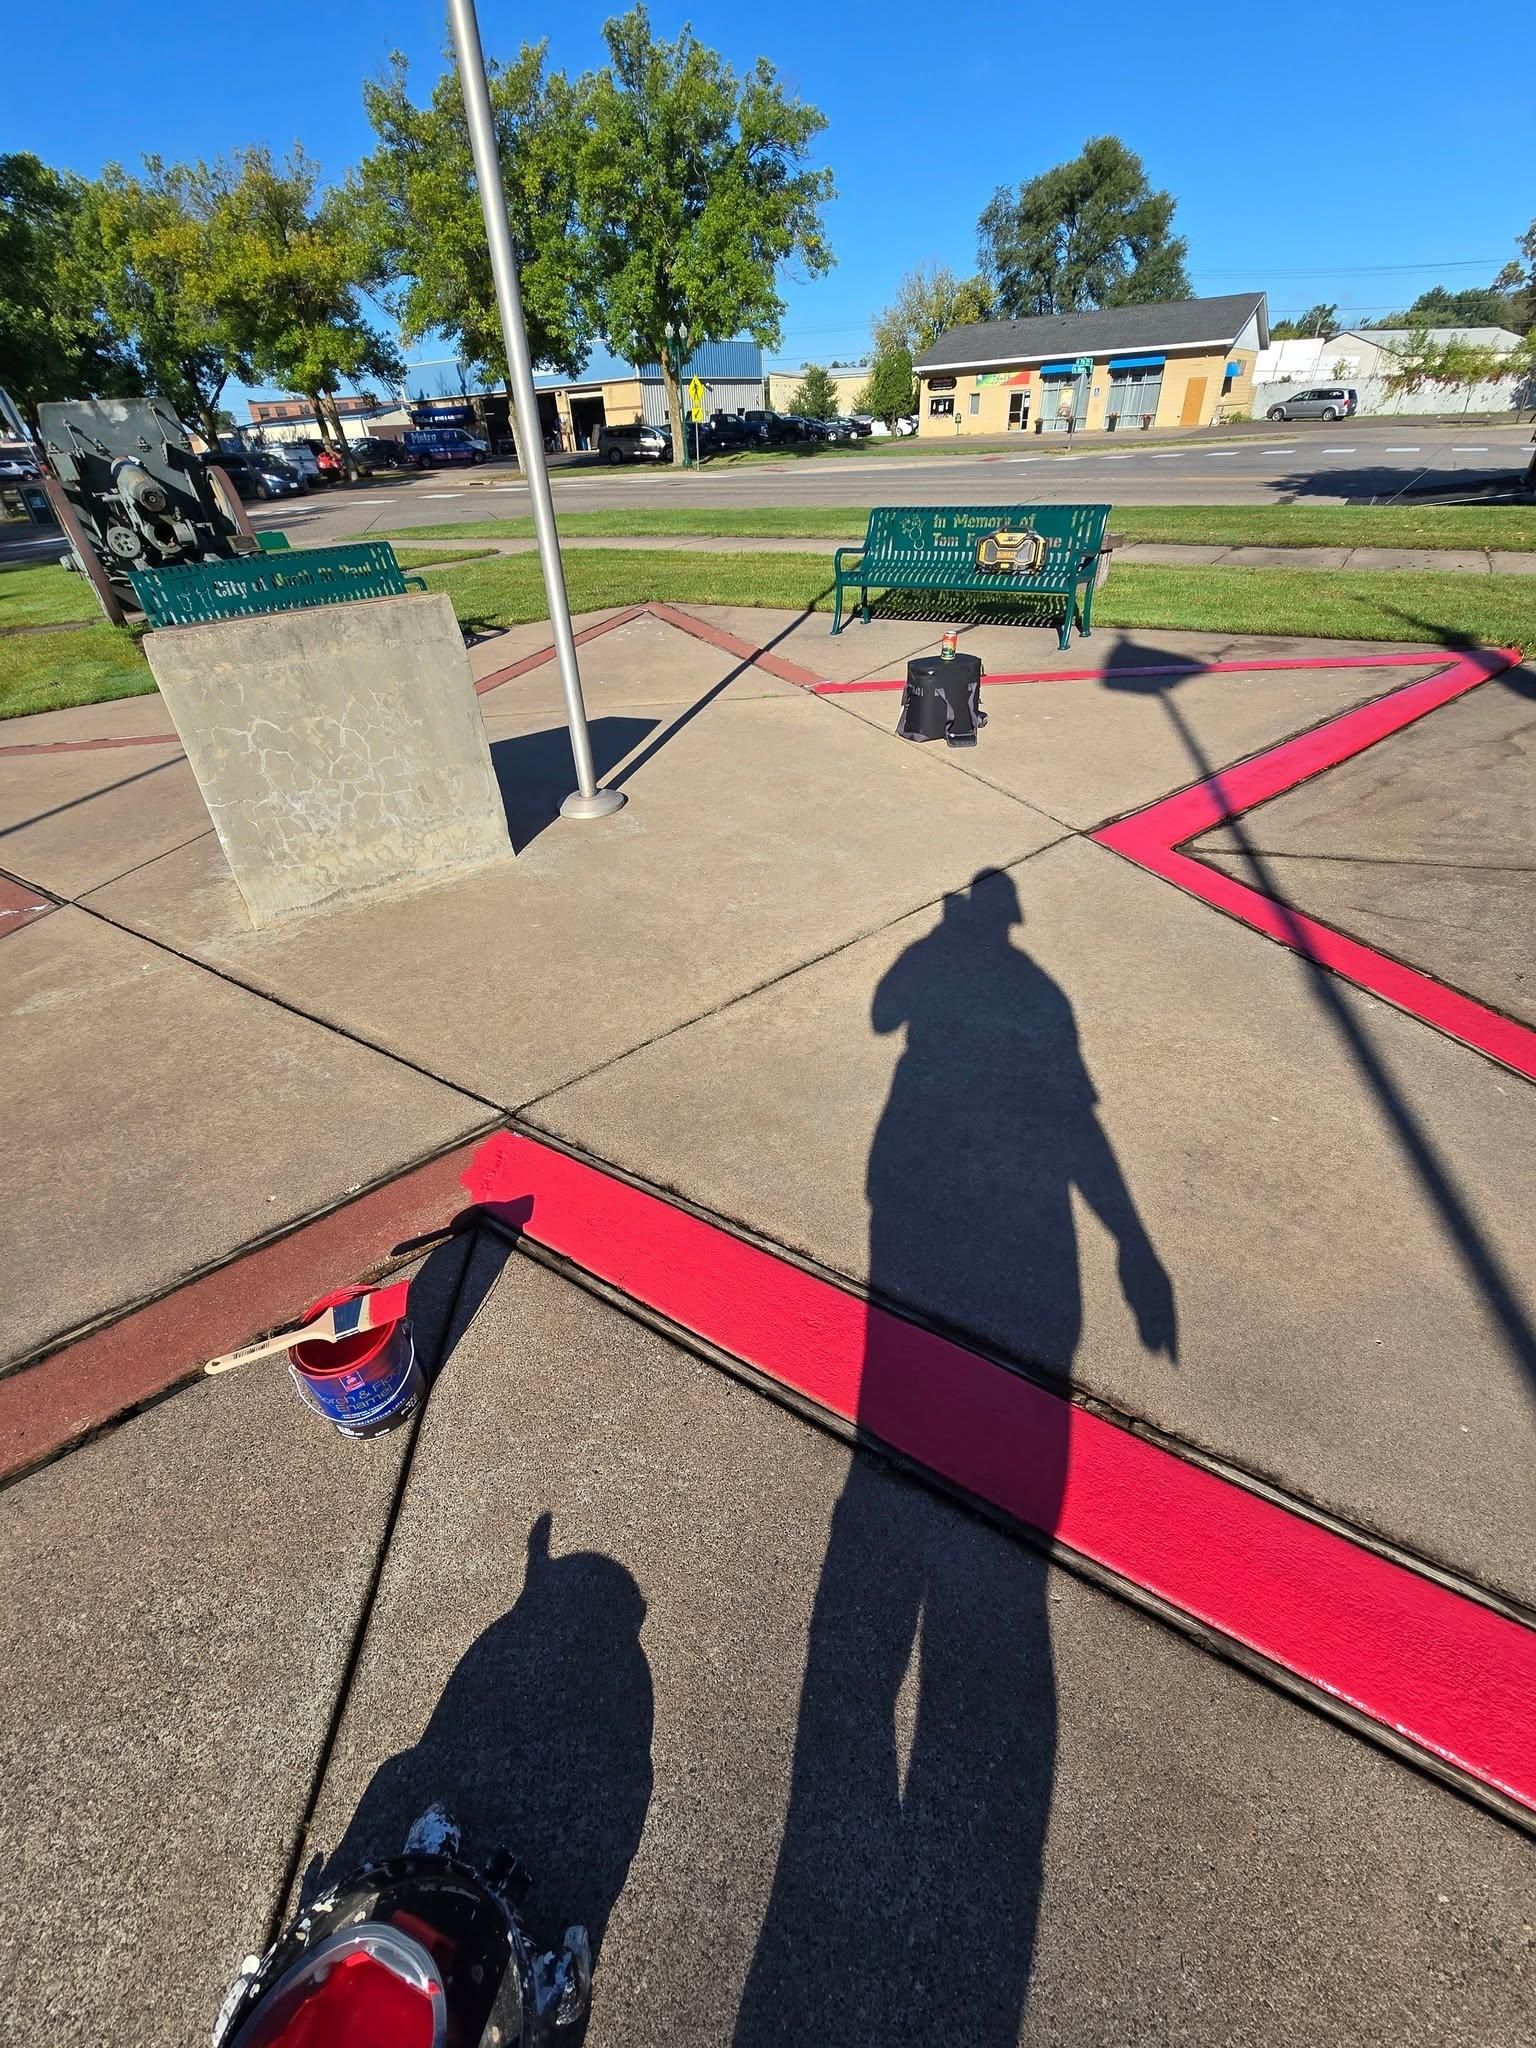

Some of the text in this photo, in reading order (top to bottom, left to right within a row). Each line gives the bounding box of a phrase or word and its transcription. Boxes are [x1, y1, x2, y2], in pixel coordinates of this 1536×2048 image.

[410, 432, 437, 443] Metro
[934, 513, 1036, 529] In Memory of
[933, 532, 959, 547] Tom
[214, 580, 247, 599] City
[252, 576, 268, 592] of
[338, 562, 372, 580] Paul
[335, 1384, 393, 1412] Enamel
[359, 1390, 371, 1399] &
